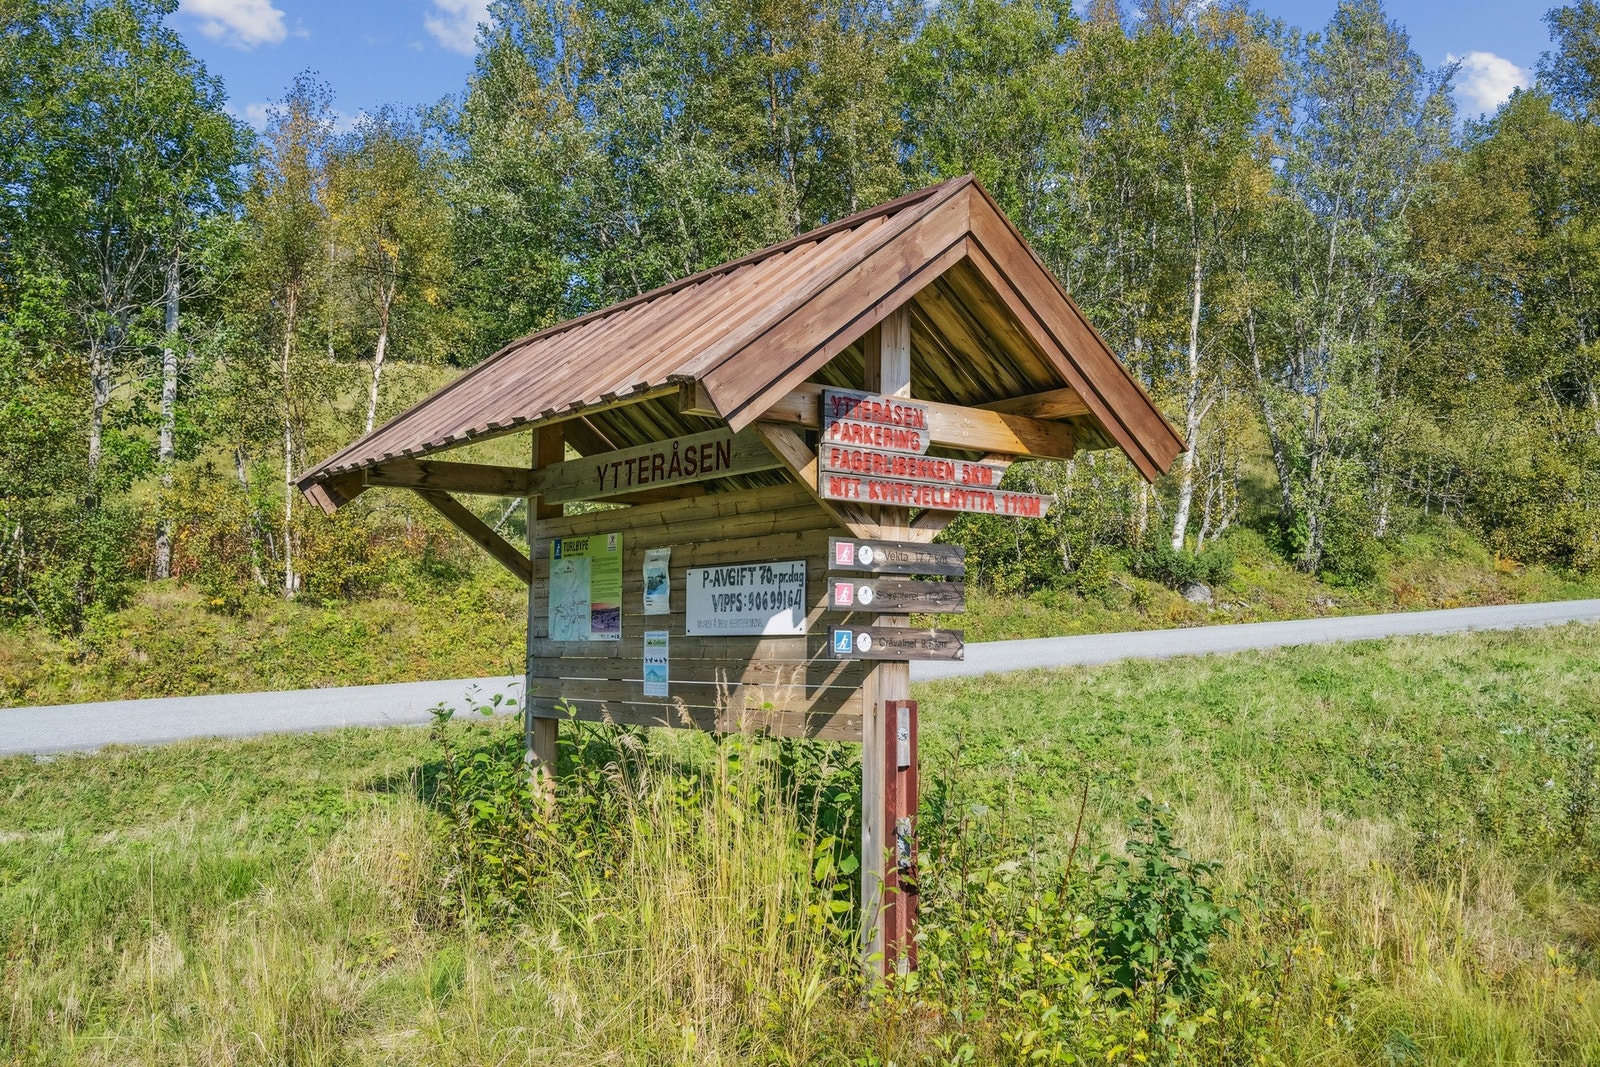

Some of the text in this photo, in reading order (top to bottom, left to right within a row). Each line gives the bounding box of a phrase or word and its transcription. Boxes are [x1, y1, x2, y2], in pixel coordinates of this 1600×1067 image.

[830, 395, 925, 428] YTTERÅSEN
[830, 420, 921, 452] PARKERING
[597, 439, 731, 492] YTTERÅSEN
[962, 463, 993, 486] 5KM
[1002, 494, 1041, 517] 11KM
[883, 549, 909, 562] Vekta
[702, 566, 757, 589] P-AVGIFT
